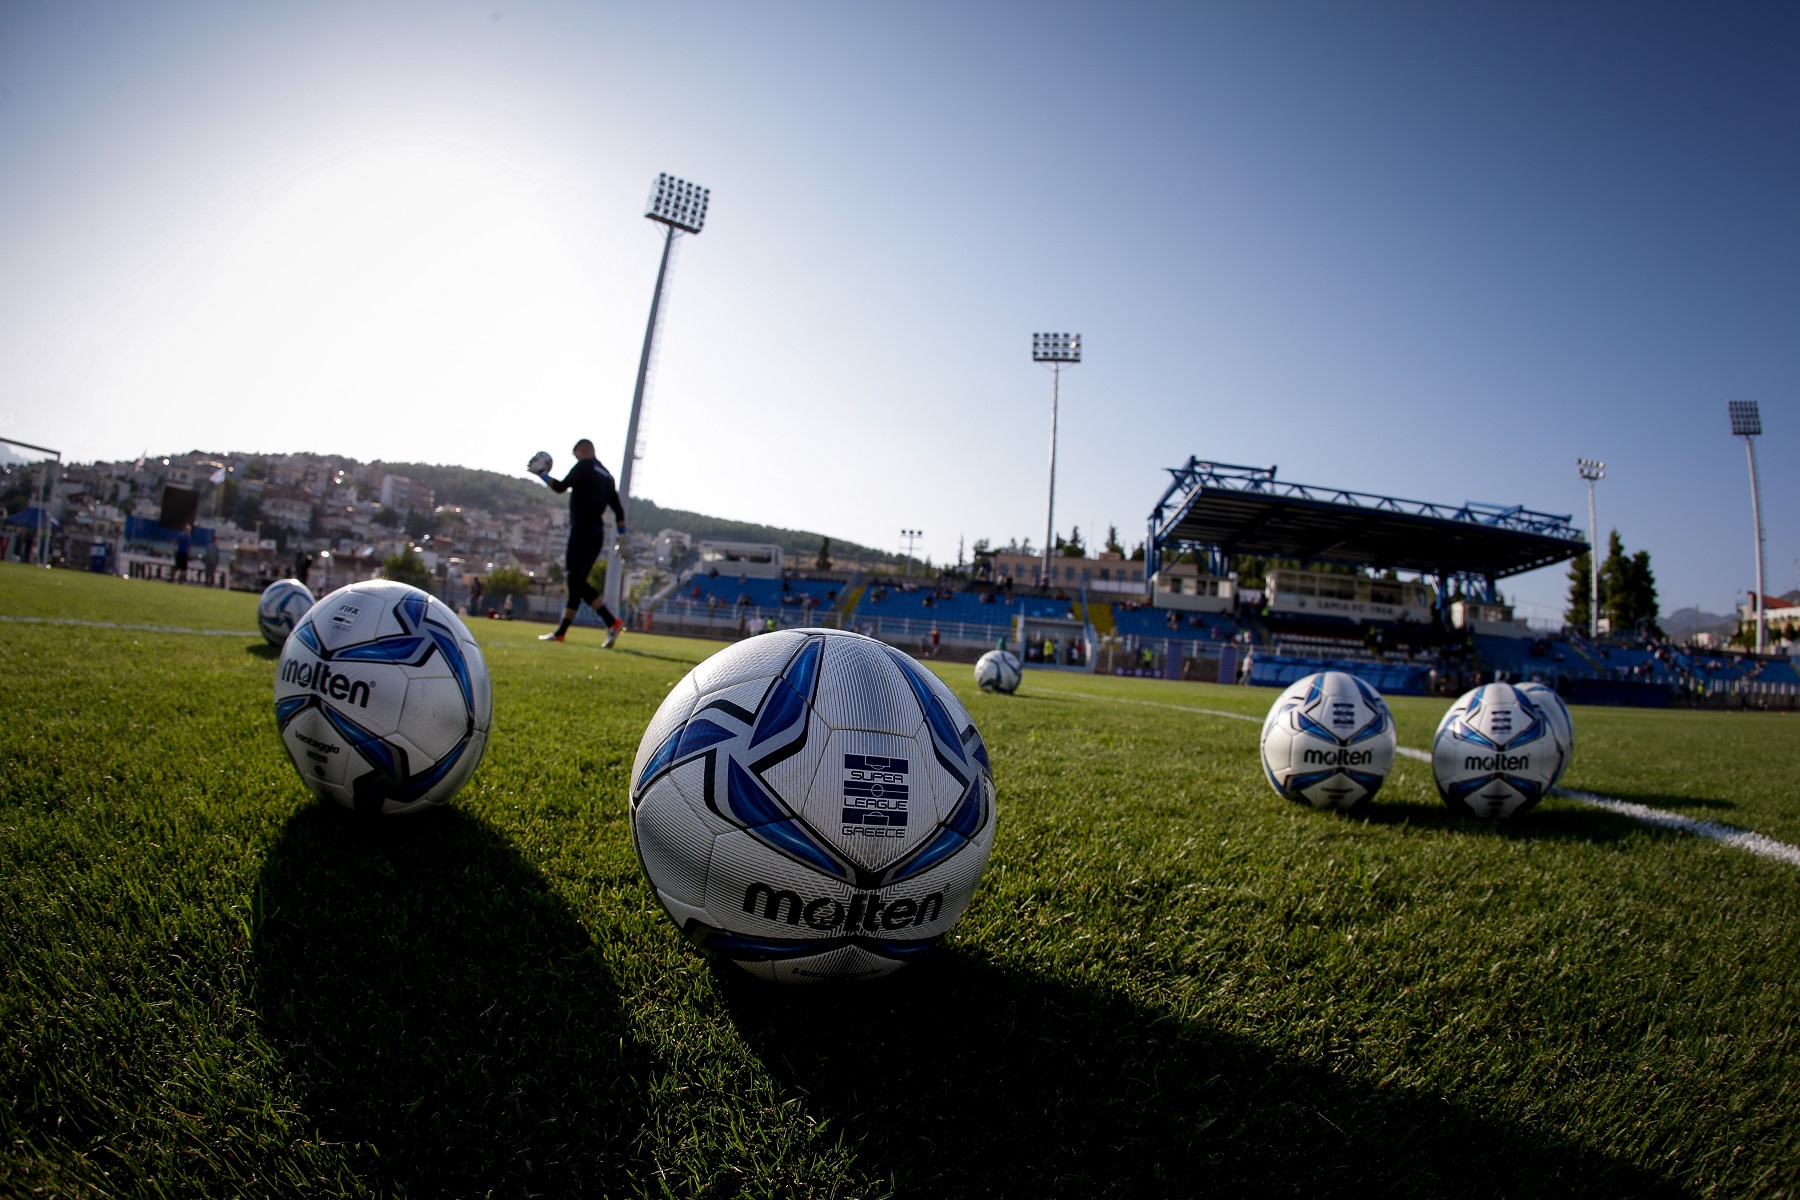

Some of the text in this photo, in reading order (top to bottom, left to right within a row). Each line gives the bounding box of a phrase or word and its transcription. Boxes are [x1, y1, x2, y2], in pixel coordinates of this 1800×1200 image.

[339, 604, 360, 615] FIFA
[282, 659, 370, 708] molten
[1304, 748, 1372, 765] molten
[1465, 753, 1529, 771] molten
[851, 770, 903, 783] SUPER
[844, 797, 907, 811] LEAGUE
[842, 826, 905, 838] GREECE
[742, 882, 944, 931] molten
